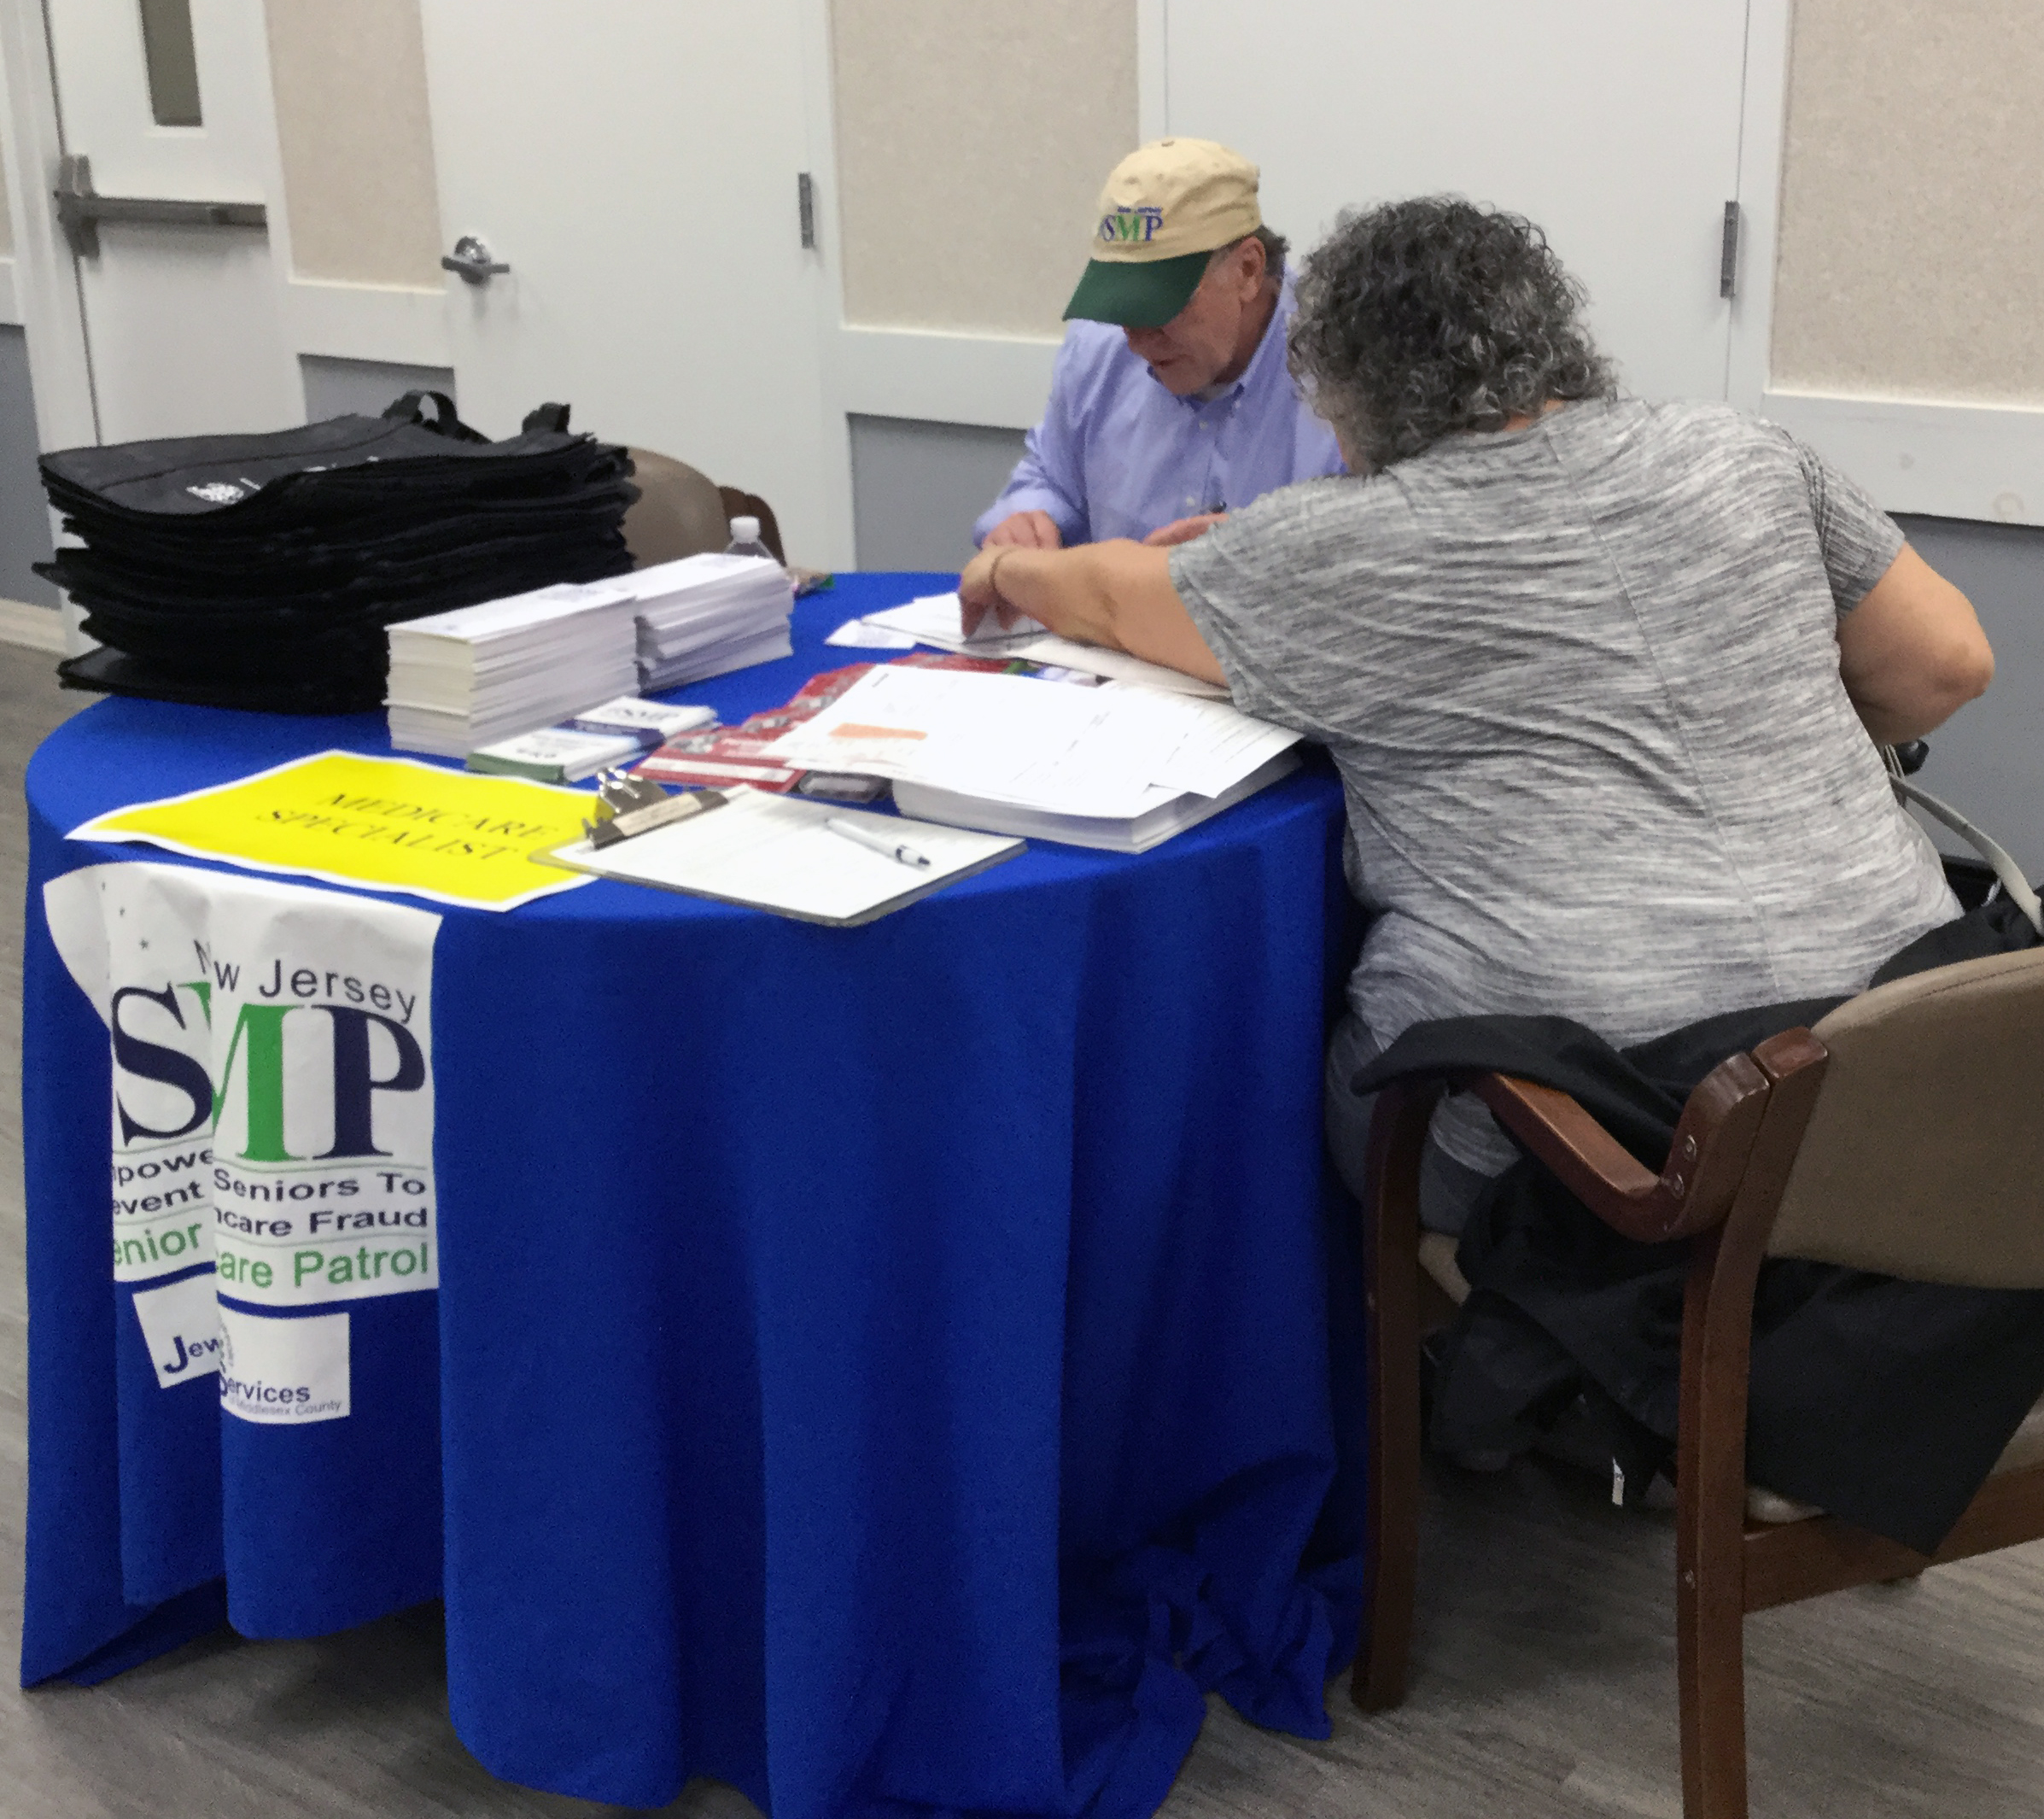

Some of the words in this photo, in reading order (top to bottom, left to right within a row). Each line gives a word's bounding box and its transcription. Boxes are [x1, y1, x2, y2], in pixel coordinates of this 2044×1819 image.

[1100, 213, 1163, 243] SMP
[256, 810, 519, 859] SPECIALIST
[318, 793, 559, 839] MEDICARE
[259, 958, 416, 1024] Jersey
[112, 982, 426, 1162] SMP
[213, 1167, 360, 1202] Seniors
[377, 1172, 426, 1196] To
[309, 1206, 428, 1235] Fraud
[294, 1242, 428, 1289] Patrol
[295, 1399, 342, 1416] County
